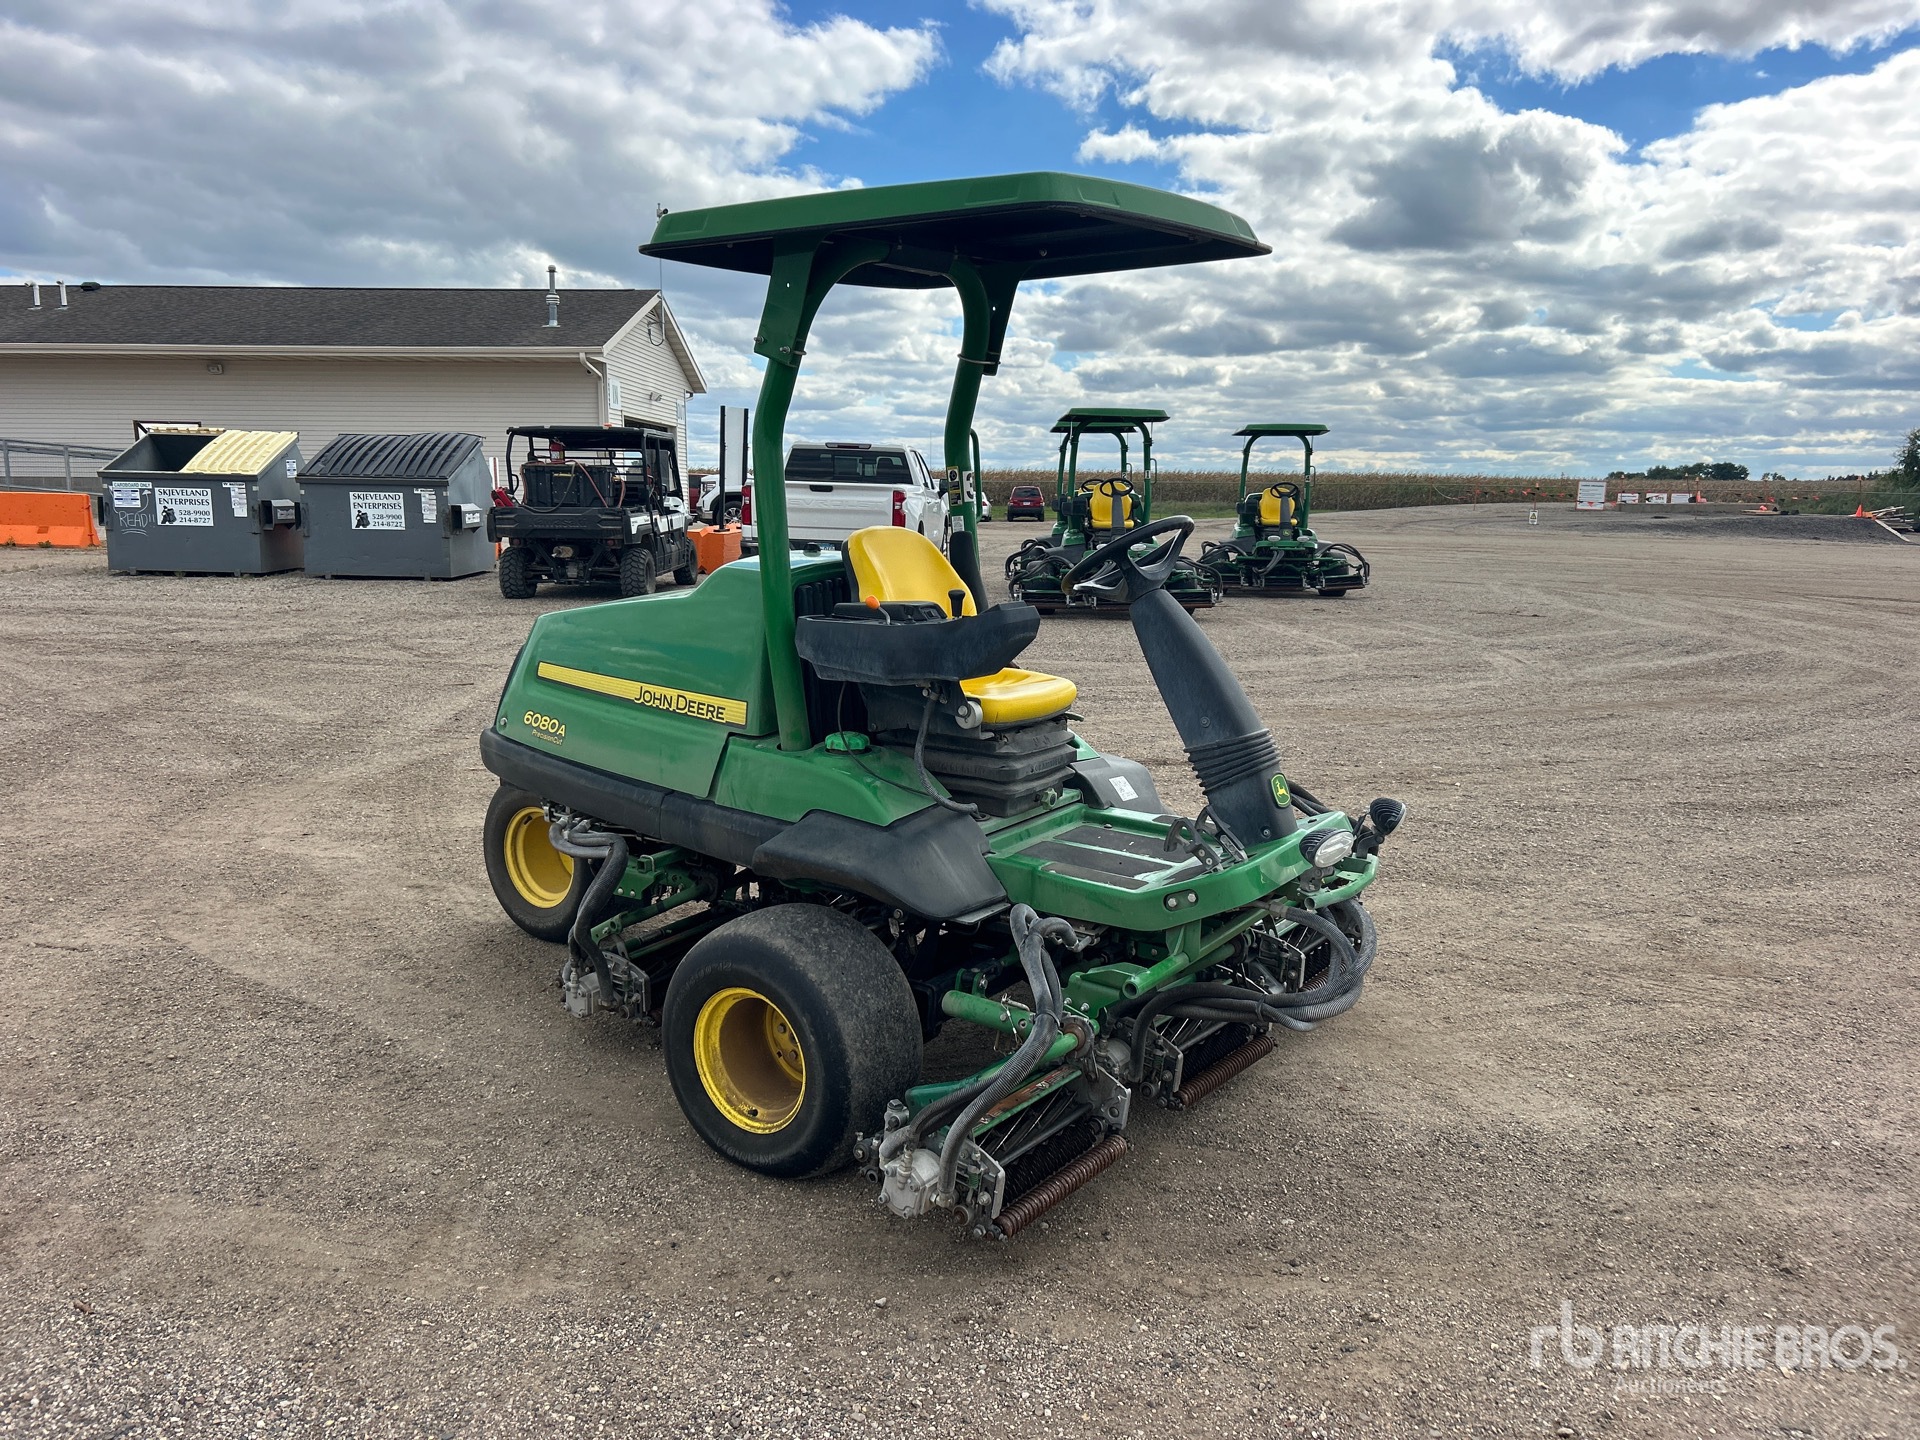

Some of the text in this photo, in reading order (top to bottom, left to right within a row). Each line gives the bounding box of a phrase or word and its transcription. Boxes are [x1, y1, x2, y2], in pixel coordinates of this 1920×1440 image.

[157, 488, 209, 497] SKJEVELAND
[352, 492, 401, 501] SKJEVELAND
[158, 497, 210, 506] ENTERPRISES
[353, 502, 402, 510] ENTERPRISES
[178, 509, 211, 517] 528-9900
[179, 516, 211, 524] 214-8727
[372, 520, 403, 528] 214-8727
[634, 686, 727, 721] JOHN DEERE
[523, 710, 566, 737] 6080A
